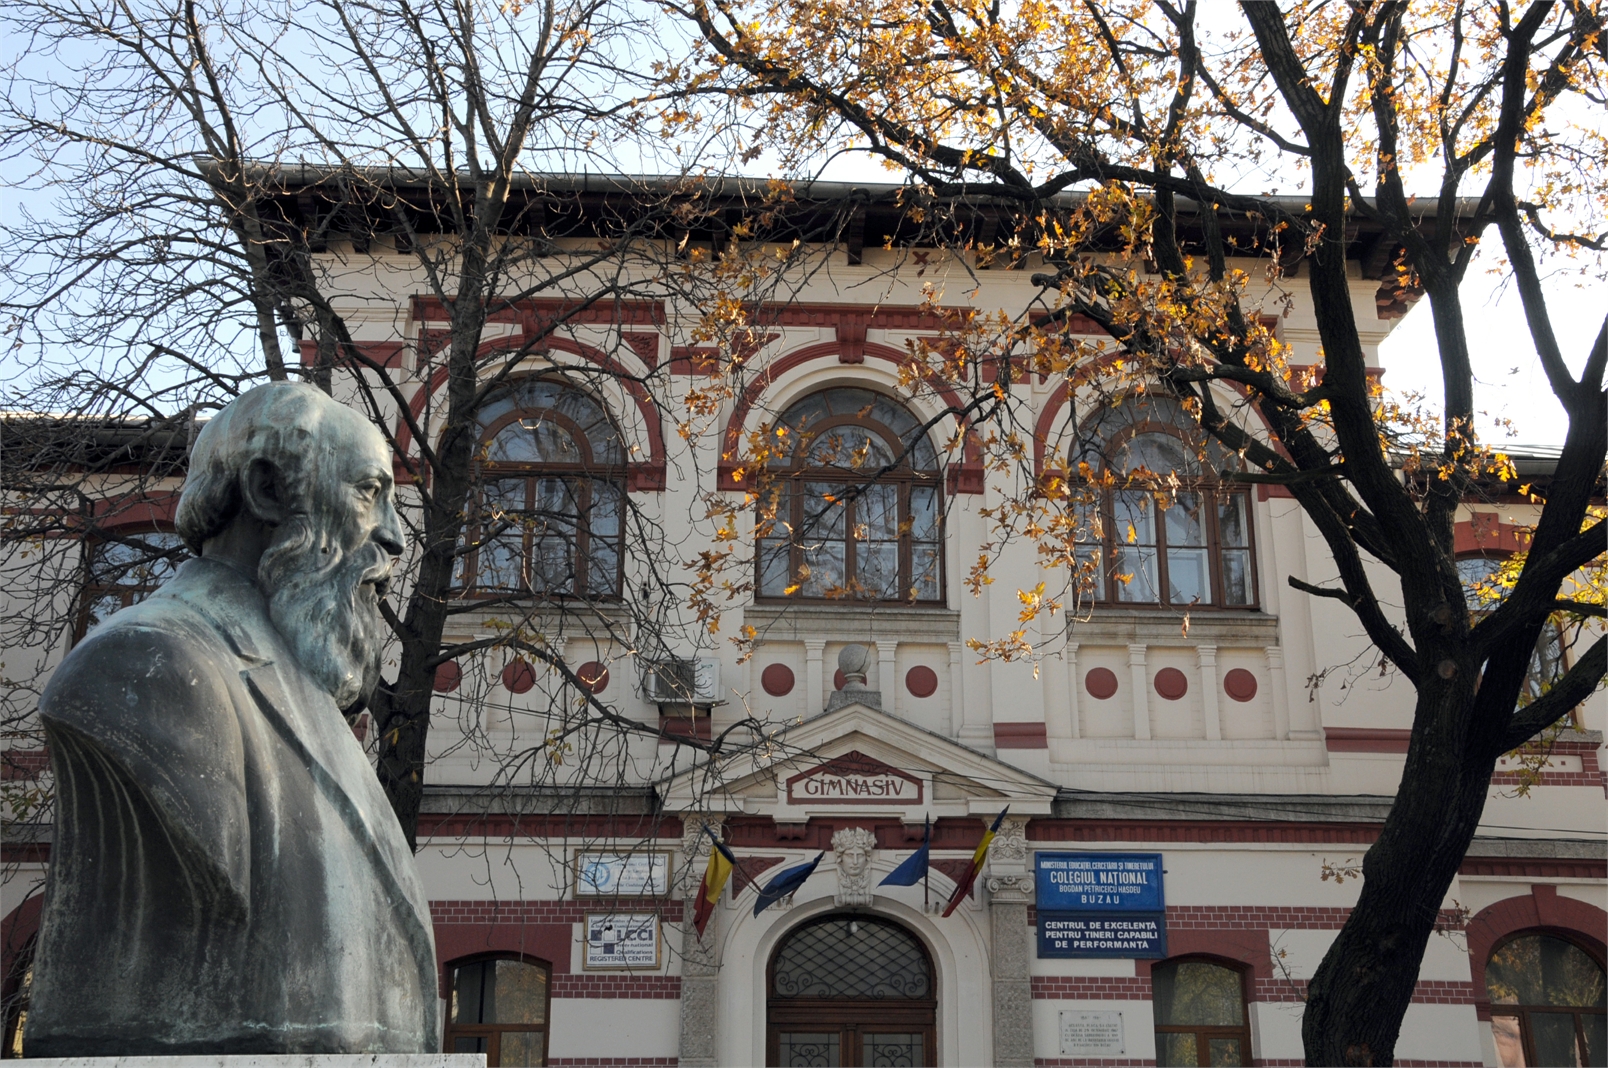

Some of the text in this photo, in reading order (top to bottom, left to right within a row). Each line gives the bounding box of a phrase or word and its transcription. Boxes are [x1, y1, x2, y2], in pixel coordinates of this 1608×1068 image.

[804, 779, 904, 796] GIMNASIV
[1050, 871, 1096, 884] COLEGIUL
[1059, 885, 1141, 894] BOGDAN PETRICEICU HASDEU
[1045, 921, 1086, 929] CENTRUL
[1089, 921, 1101, 929] DE
[616, 929, 653, 941] LCCI
[1084, 931, 1115, 939] TINERI
[1117, 931, 1158, 939] CAPABILI
[1055, 940, 1068, 948] DE
